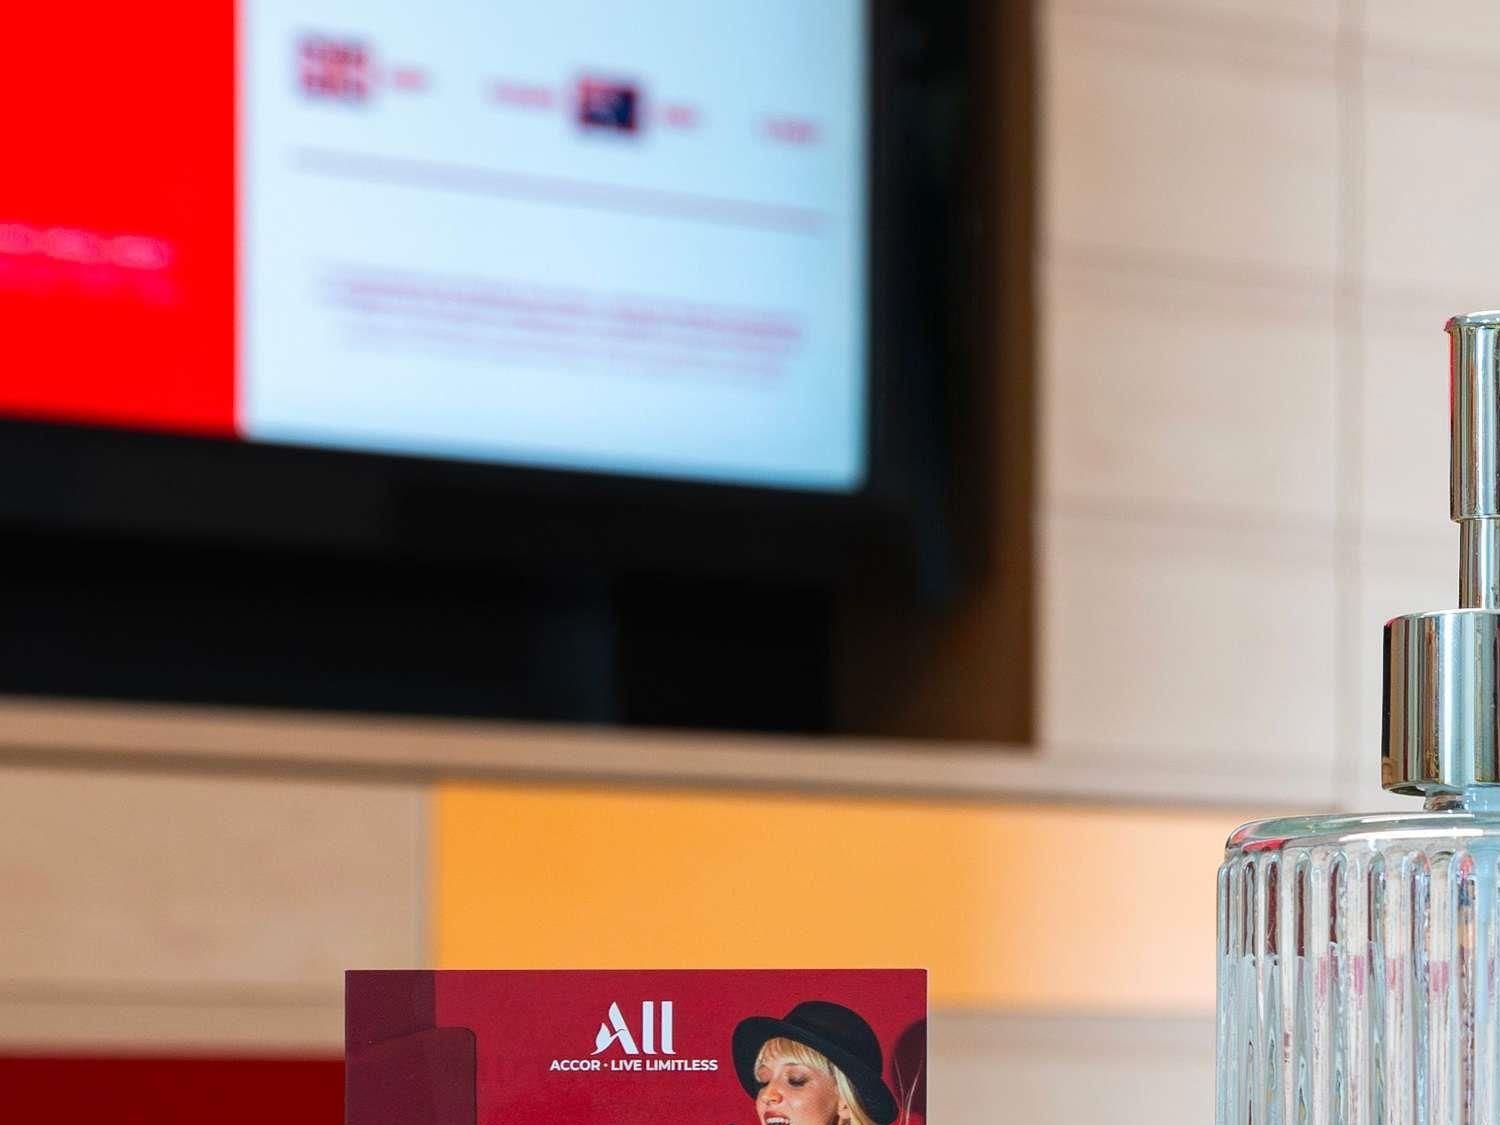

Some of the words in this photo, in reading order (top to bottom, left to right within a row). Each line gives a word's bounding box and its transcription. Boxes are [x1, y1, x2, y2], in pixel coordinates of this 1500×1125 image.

[550, 1060, 600, 1071] ACCOR
[611, 1060, 642, 1071] LIVE
[646, 1060, 718, 1071] LIMITLESS
